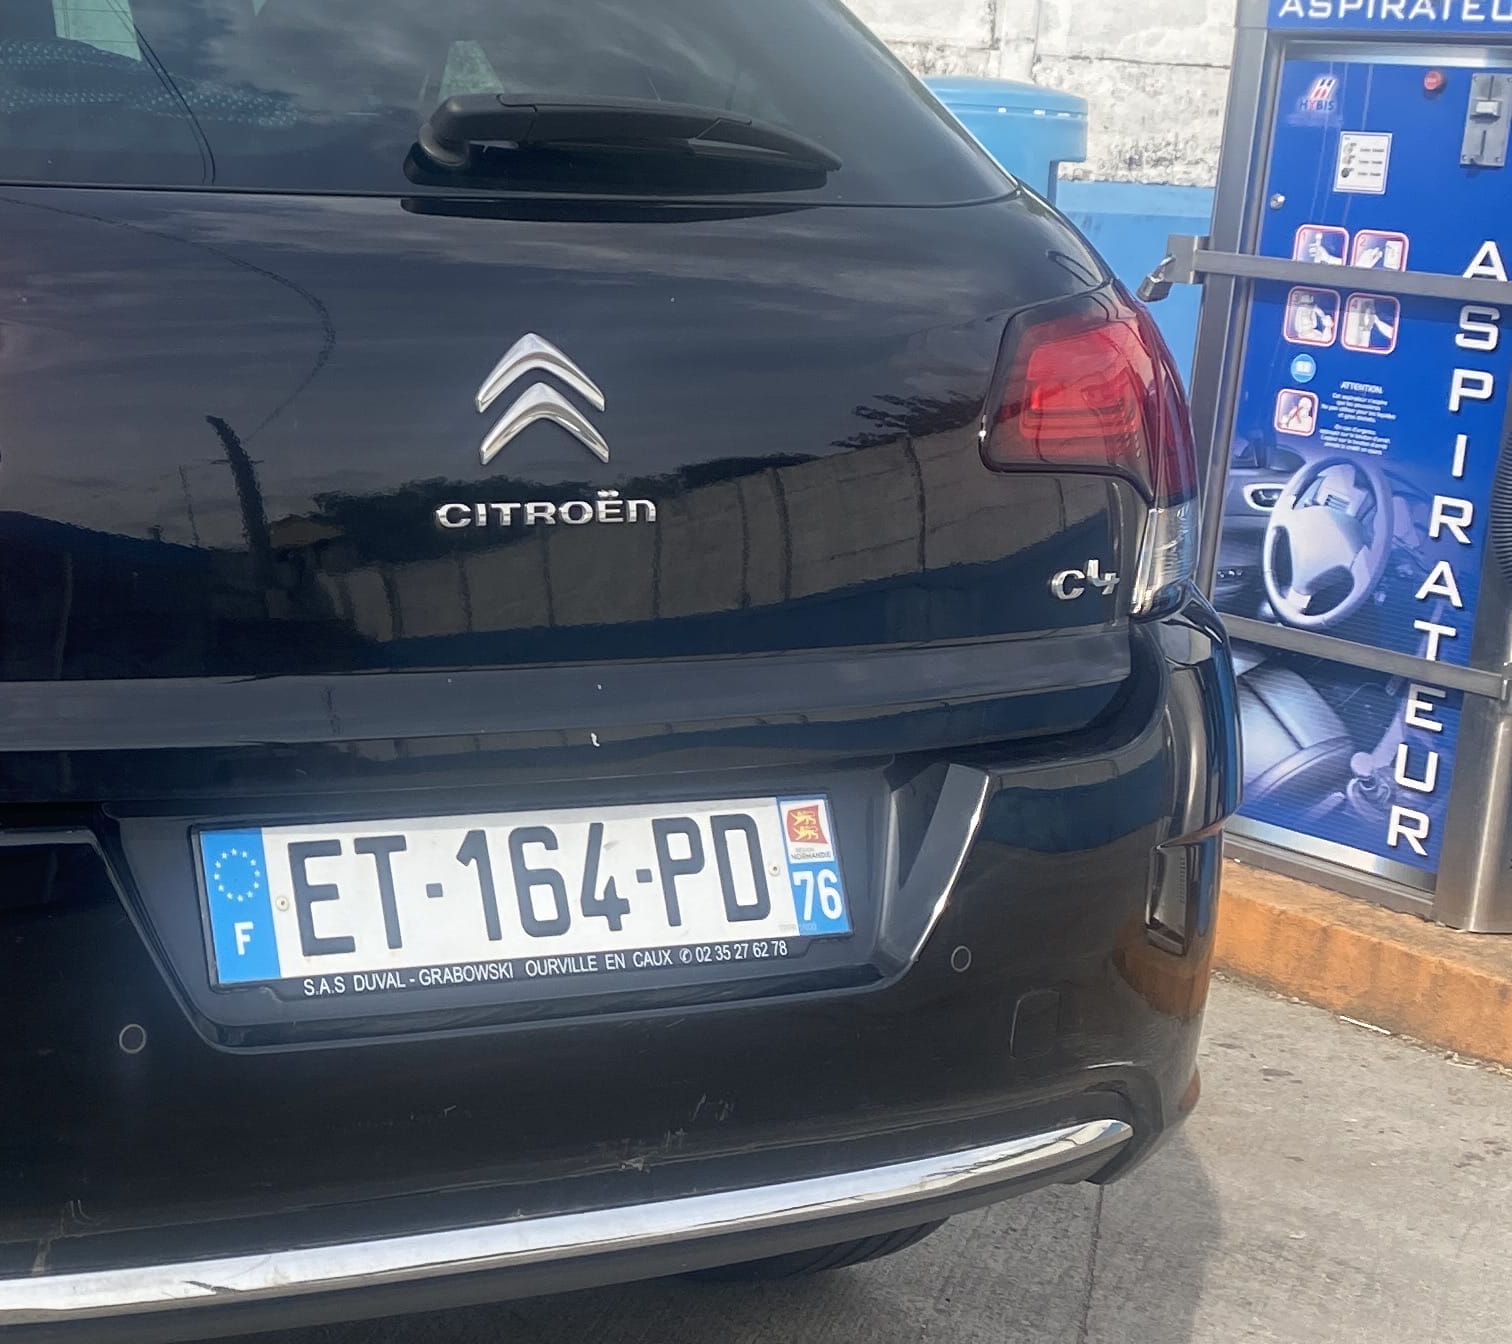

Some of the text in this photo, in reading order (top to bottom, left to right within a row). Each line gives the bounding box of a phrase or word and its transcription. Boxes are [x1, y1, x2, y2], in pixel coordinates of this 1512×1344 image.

[1300, 99, 1336, 111] HYBIS
[1387, 240, 1508, 857] ASPIRATEUR
[1050, 559, 1120, 600] C4
[792, 868, 842, 921] 76
[234, 920, 254, 955] F
[303, 976, 346, 996] S.A.S
[353, 971, 406, 992] DUVAL
[418, 963, 514, 987] GRABOWSKI
[525, 955, 598, 977] OURVILLE
[606, 952, 626, 970] EN
[633, 949, 673, 968] CAUX
[695, 945, 713, 963] 02
[715, 944, 731, 961] 35
[733, 943, 749, 960] 27
[752, 941, 769, 958] 62
[771, 940, 788, 956] 78
